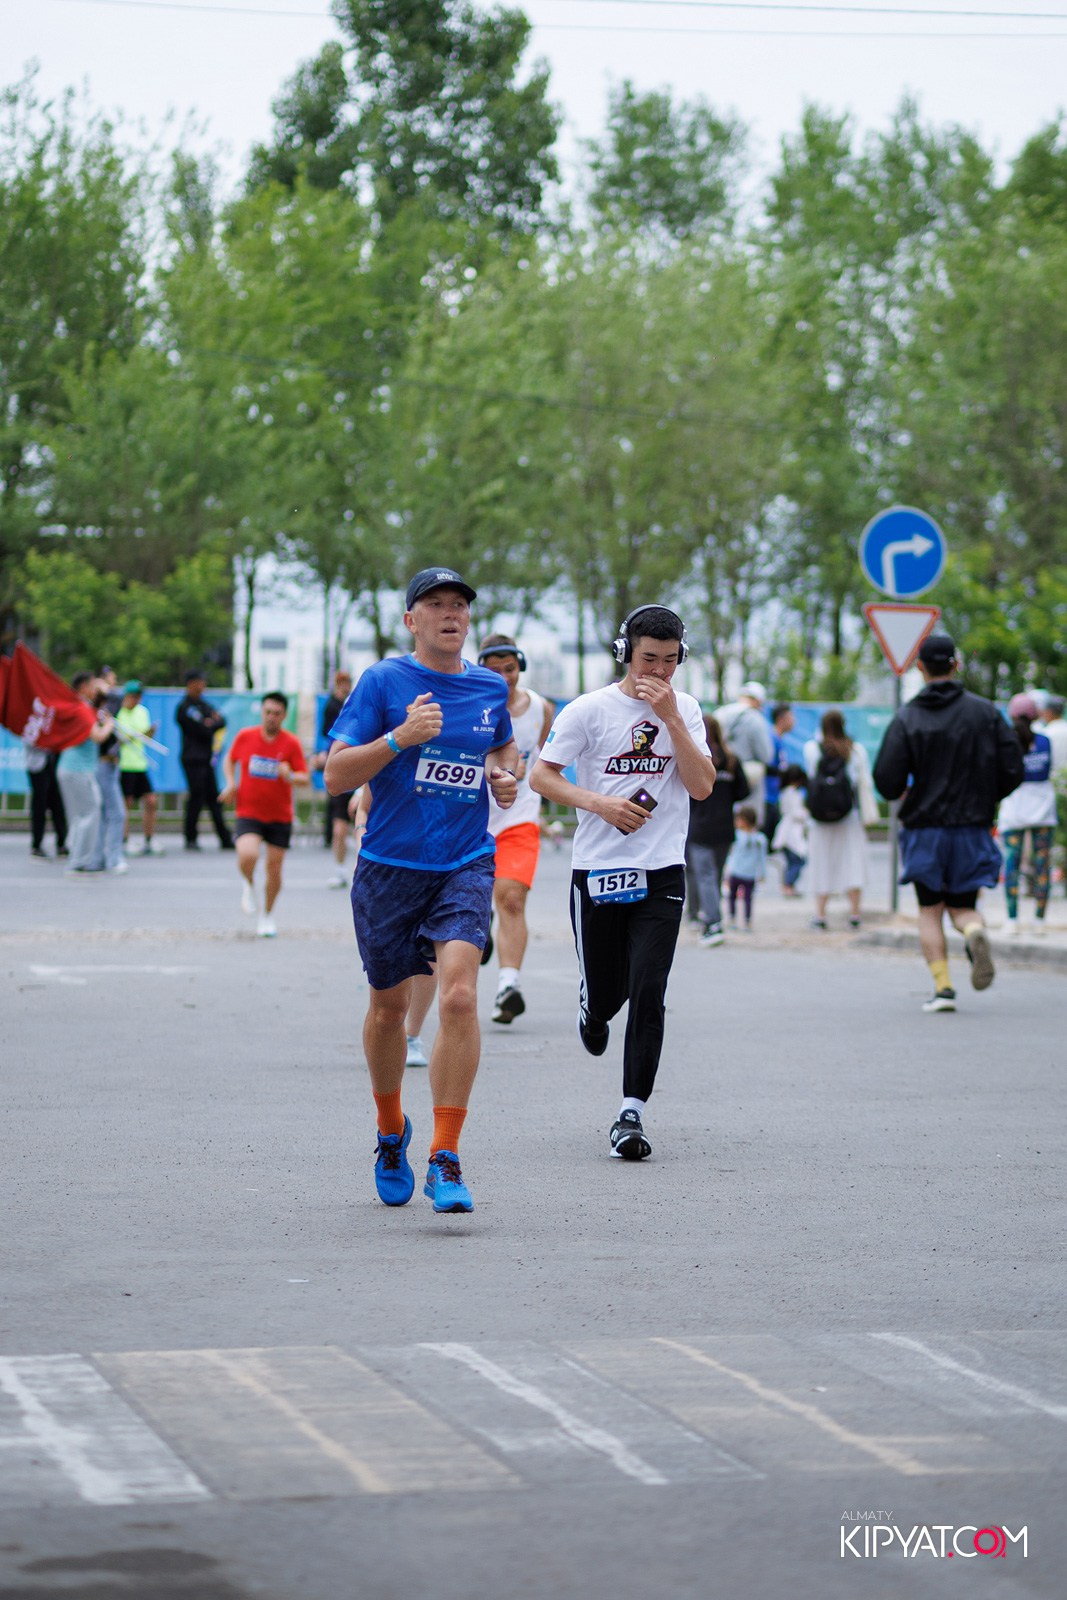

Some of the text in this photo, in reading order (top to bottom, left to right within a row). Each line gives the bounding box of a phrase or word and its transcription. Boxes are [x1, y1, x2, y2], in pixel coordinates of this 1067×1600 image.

[424, 761, 476, 786] 1699
[607, 757, 668, 773] ABYROY
[597, 871, 639, 893] 1512
